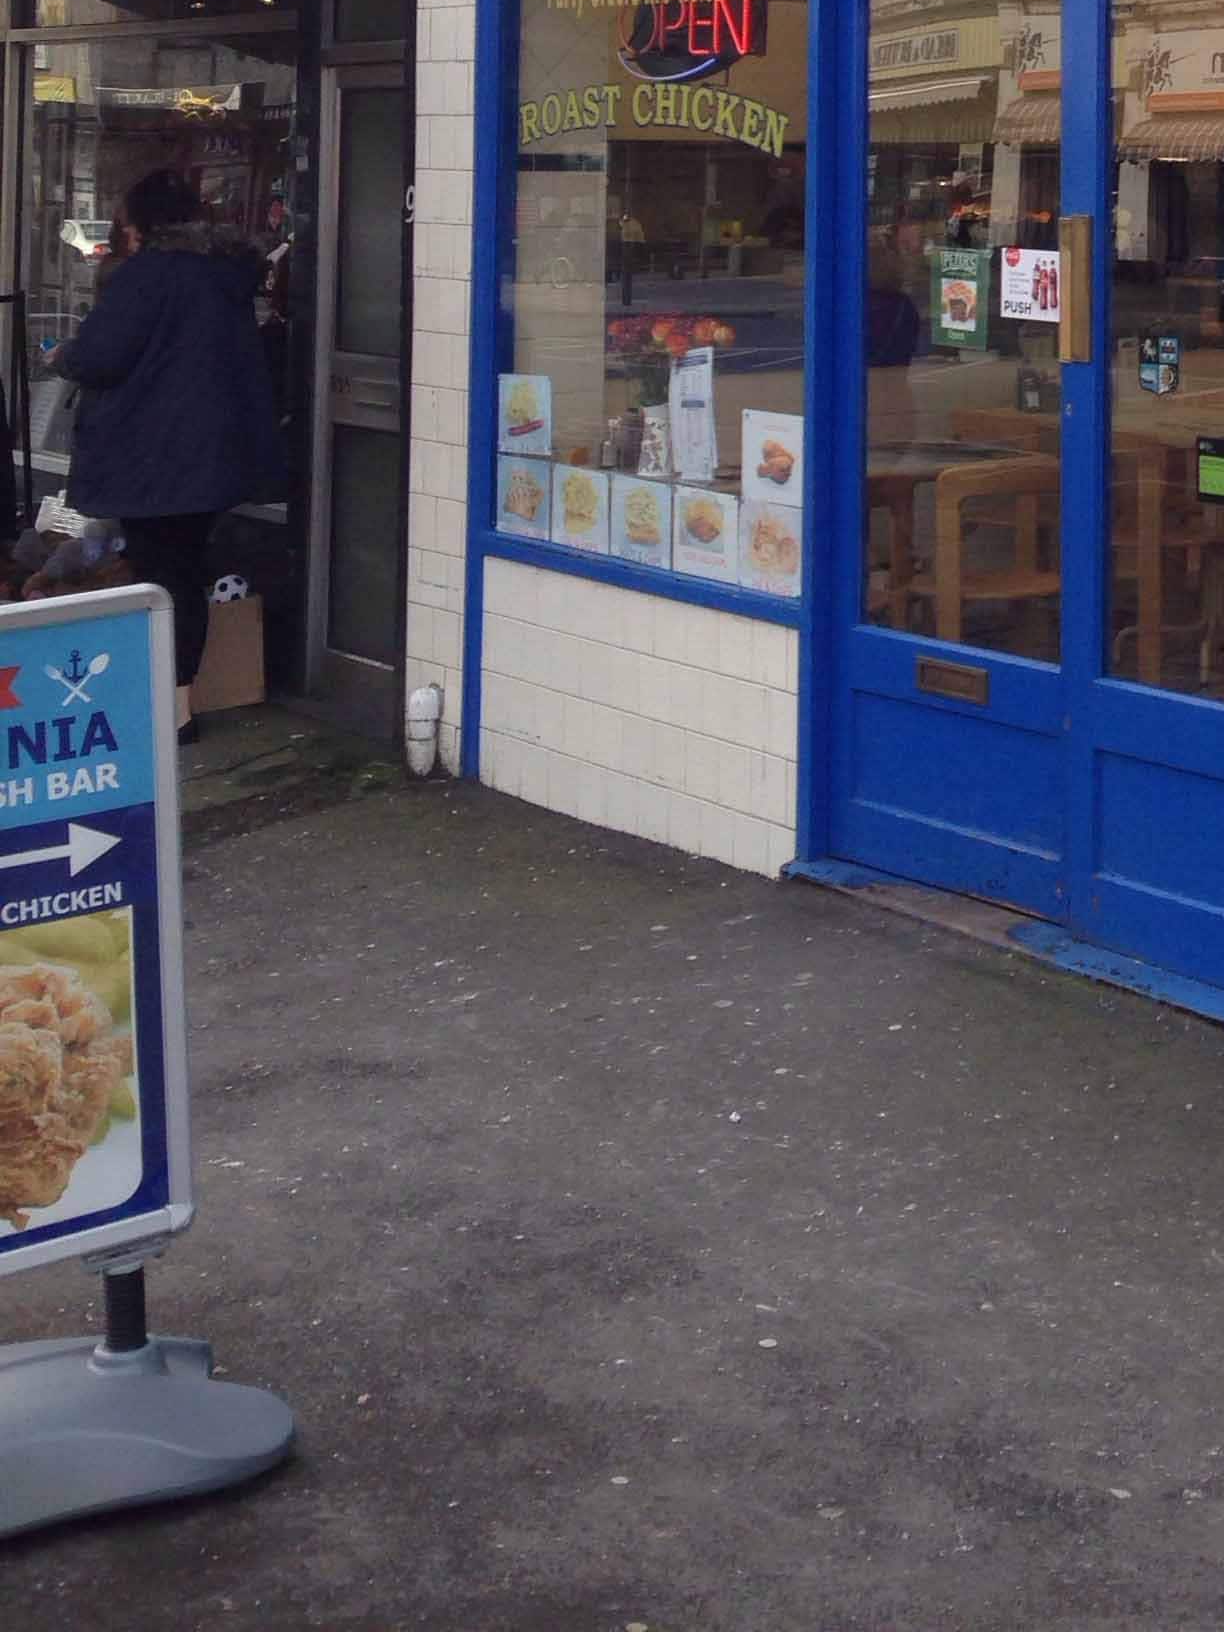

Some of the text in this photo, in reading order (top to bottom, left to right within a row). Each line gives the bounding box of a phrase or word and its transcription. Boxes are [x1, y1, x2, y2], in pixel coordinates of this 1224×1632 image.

[519, 82, 790, 159] ROAST CHICKEN
[1003, 300, 1032, 315] PUSH
[7, 710, 119, 769] NIA
[47, 763, 120, 801] BAR
[1, 880, 123, 925] CHICKEN
